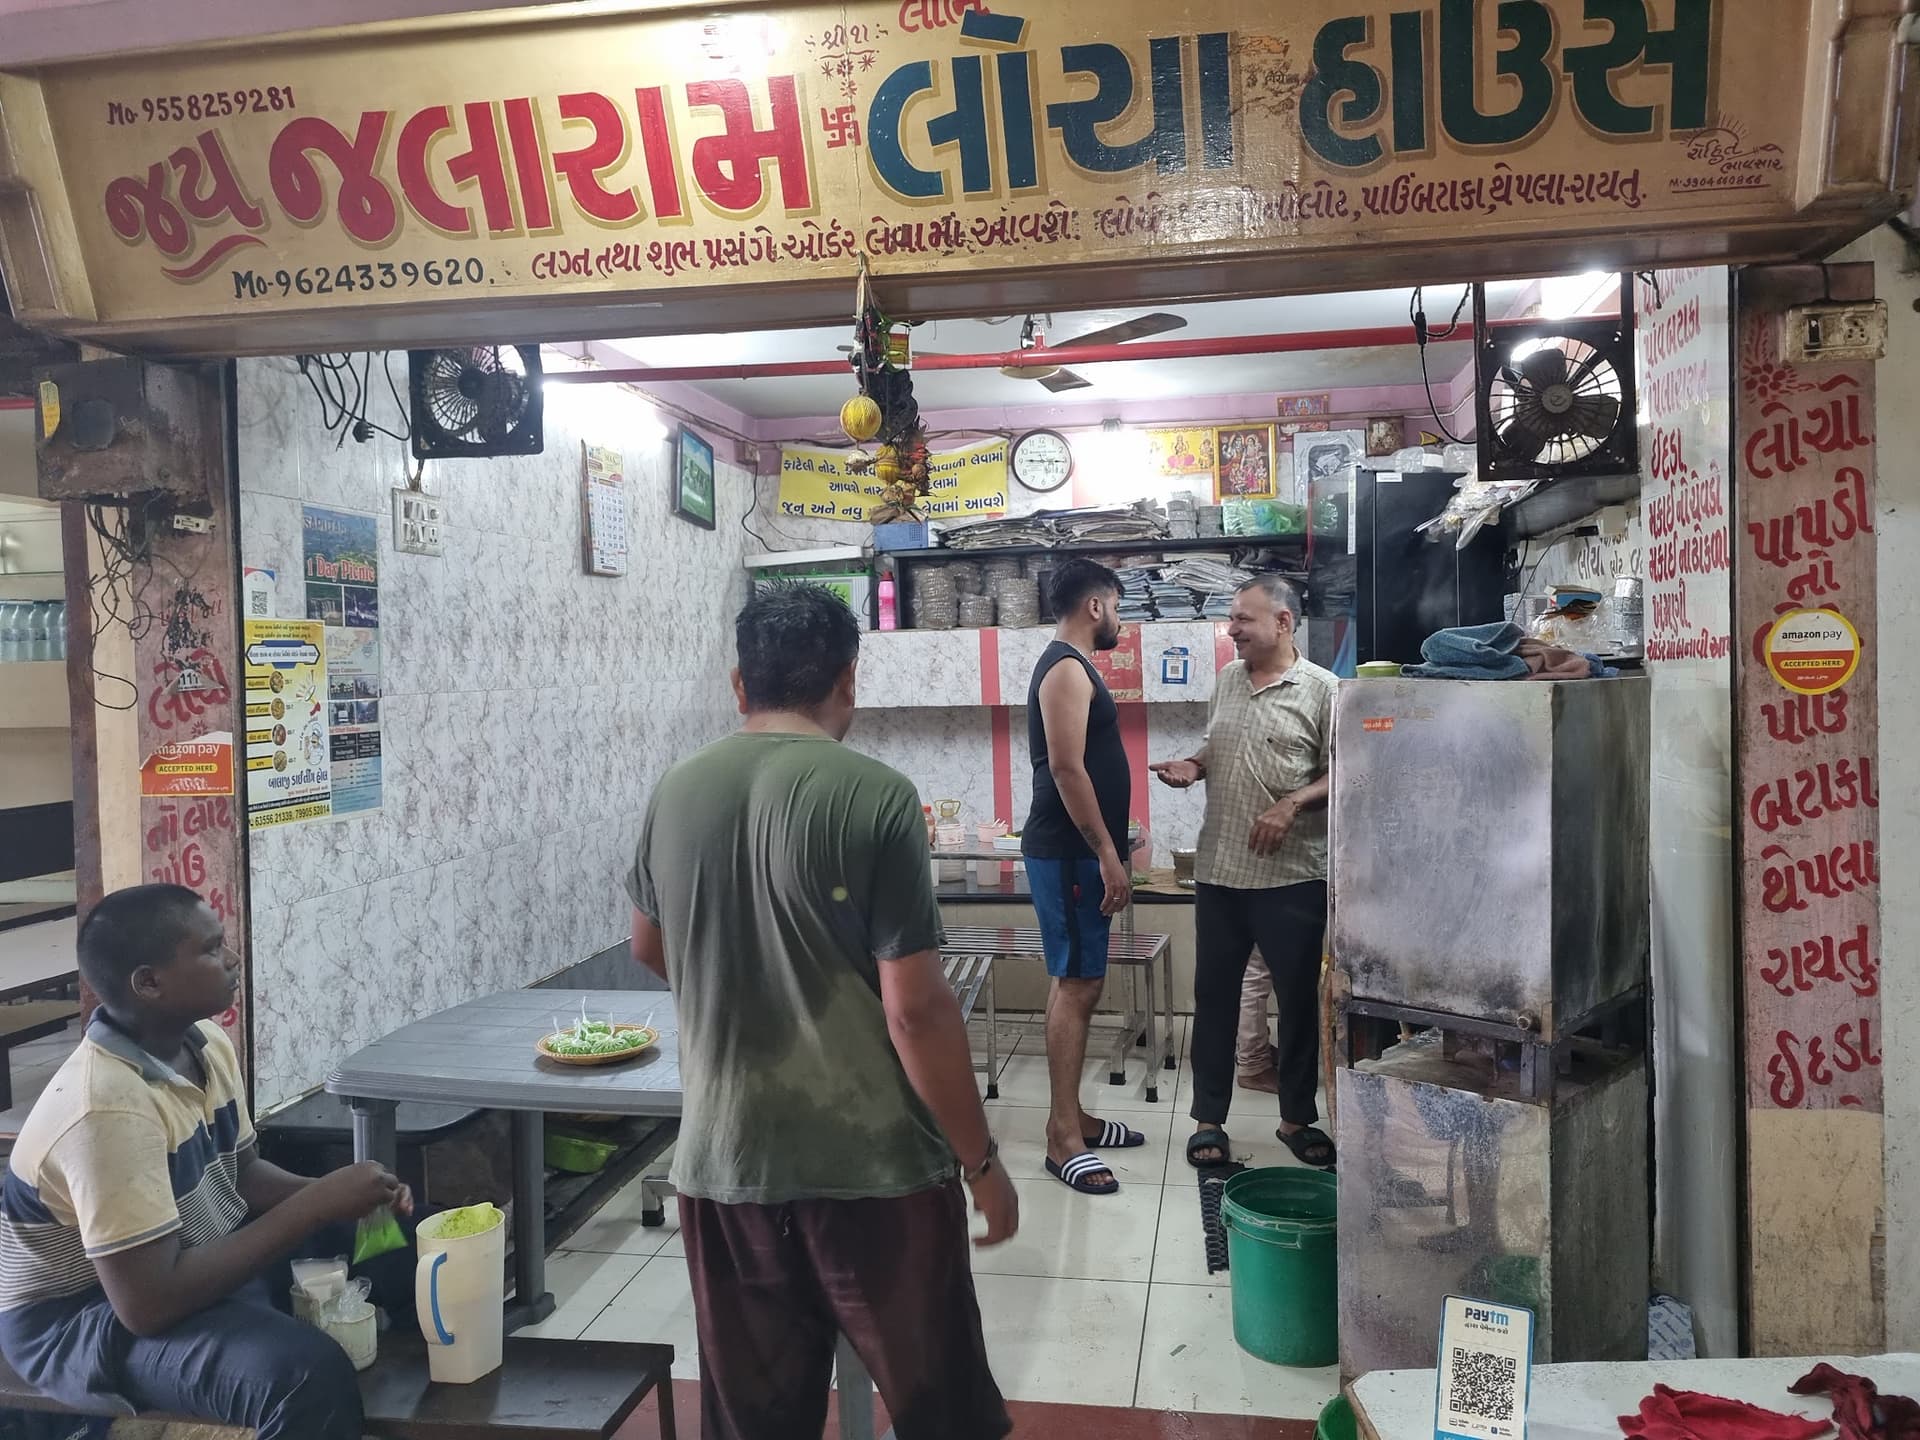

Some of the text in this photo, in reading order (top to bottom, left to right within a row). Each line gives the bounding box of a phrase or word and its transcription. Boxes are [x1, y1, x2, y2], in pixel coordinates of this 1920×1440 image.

[105, 0, 1711, 255] જય જલારામ લોચા હાઉસ
[595, 243, 642, 279] તથા
[646, 239, 700, 276] શુભ
[703, 225, 777, 271] પ્રસંગે
[782, 218, 857, 262] ઓર્ડર
[784, 457, 814, 472] ફાટેલી
[818, 460, 840, 477] નોટ,
[971, 446, 1003, 465] લેવામાં
[829, 481, 859, 493] આવશે
[811, 501, 835, 515] અને
[965, 492, 1004, 510] આવશે
[1748, 466, 1874, 567] પાપડી
[315, 554, 339, 583] Day
[340, 559, 375, 583] Picnic
[1787, 550, 1840, 600] નો
[1782, 631, 1842, 640] amazon pay
[198, 744, 220, 756] pay
[1761, 840, 1880, 914] થેપલા
[1465, 1307, 1509, 1326] paytm
